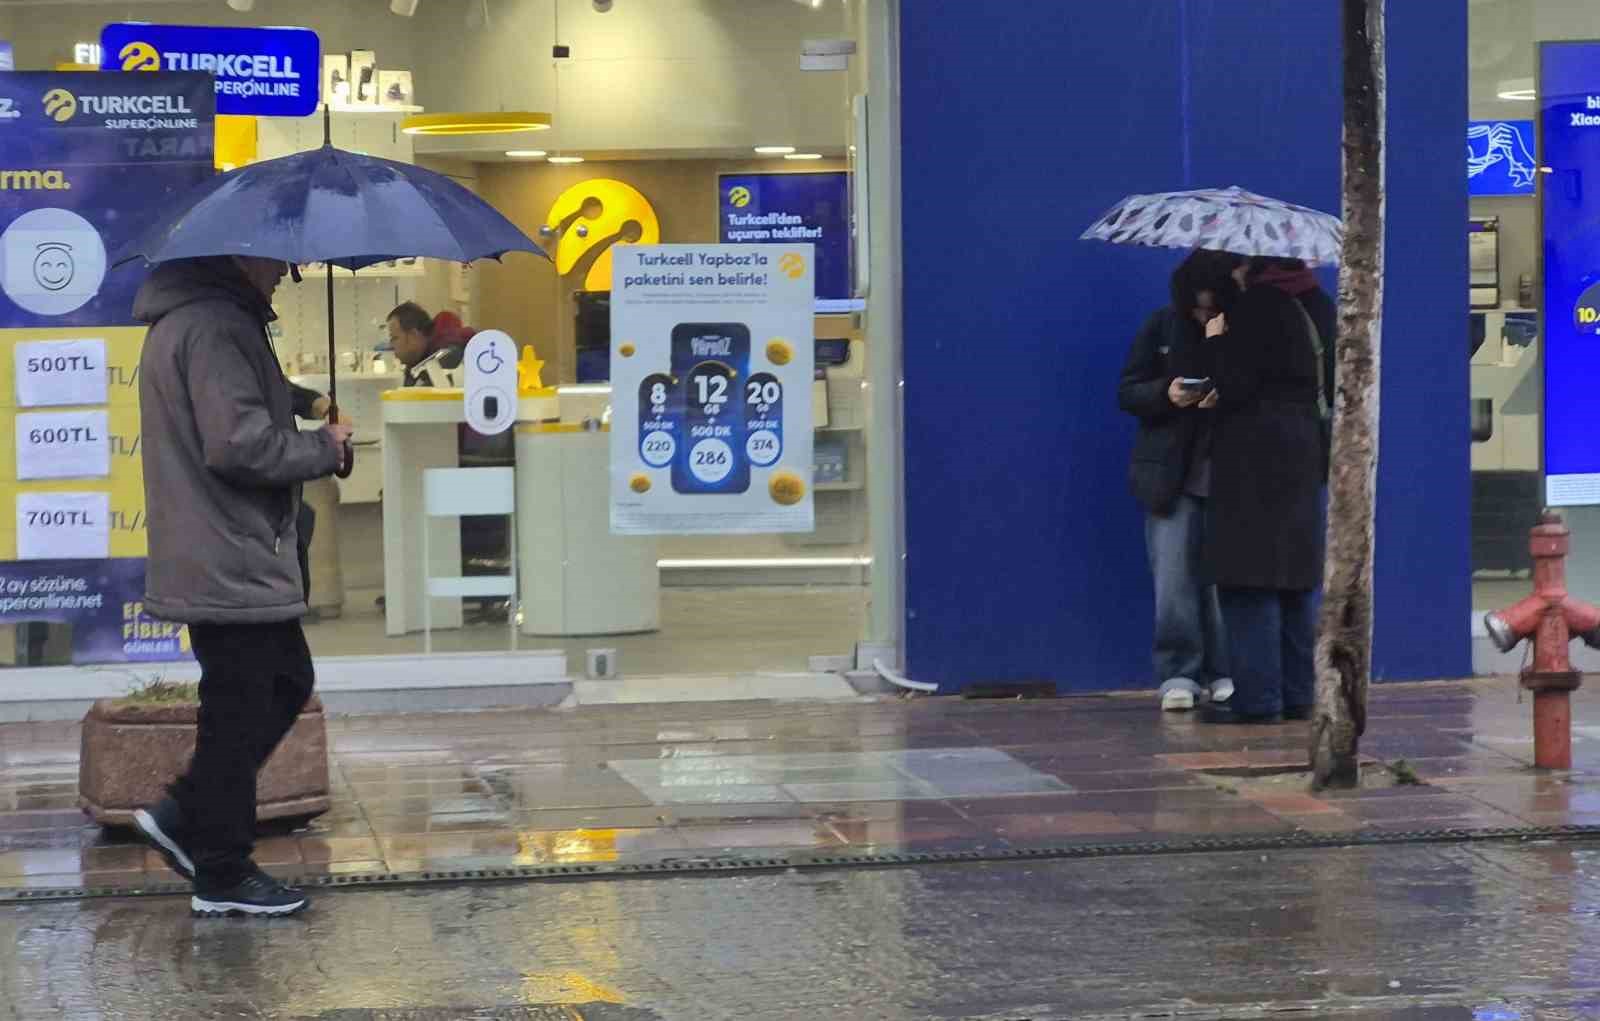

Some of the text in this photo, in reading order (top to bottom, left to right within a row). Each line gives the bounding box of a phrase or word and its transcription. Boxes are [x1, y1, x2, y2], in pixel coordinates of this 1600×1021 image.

[163, 52, 300, 79] TURKCELL
[213, 80, 300, 97] PERONLINE
[78, 95, 192, 114] TURKCELL
[104, 117, 198, 131] SUPERONLINE
[0, 169, 71, 190] rma.
[728, 212, 801, 225] Turkcell'den
[728, 226, 822, 241] uçuran teklifler!
[637, 252, 768, 268] Turkcell Yapboz'la
[624, 272, 768, 288] paketini sen belirle!
[27, 356, 96, 373] 500TL
[651, 382, 667, 404] 8
[694, 375, 728, 404] 12
[747, 382, 780, 404] 20
[29, 427, 98, 444] 600TL
[691, 426, 731, 437] 500 DK
[646, 441, 671, 452] 220
[752, 439, 774, 451] 374
[696, 451, 727, 465] 286
[26, 510, 94, 527] 700TL
